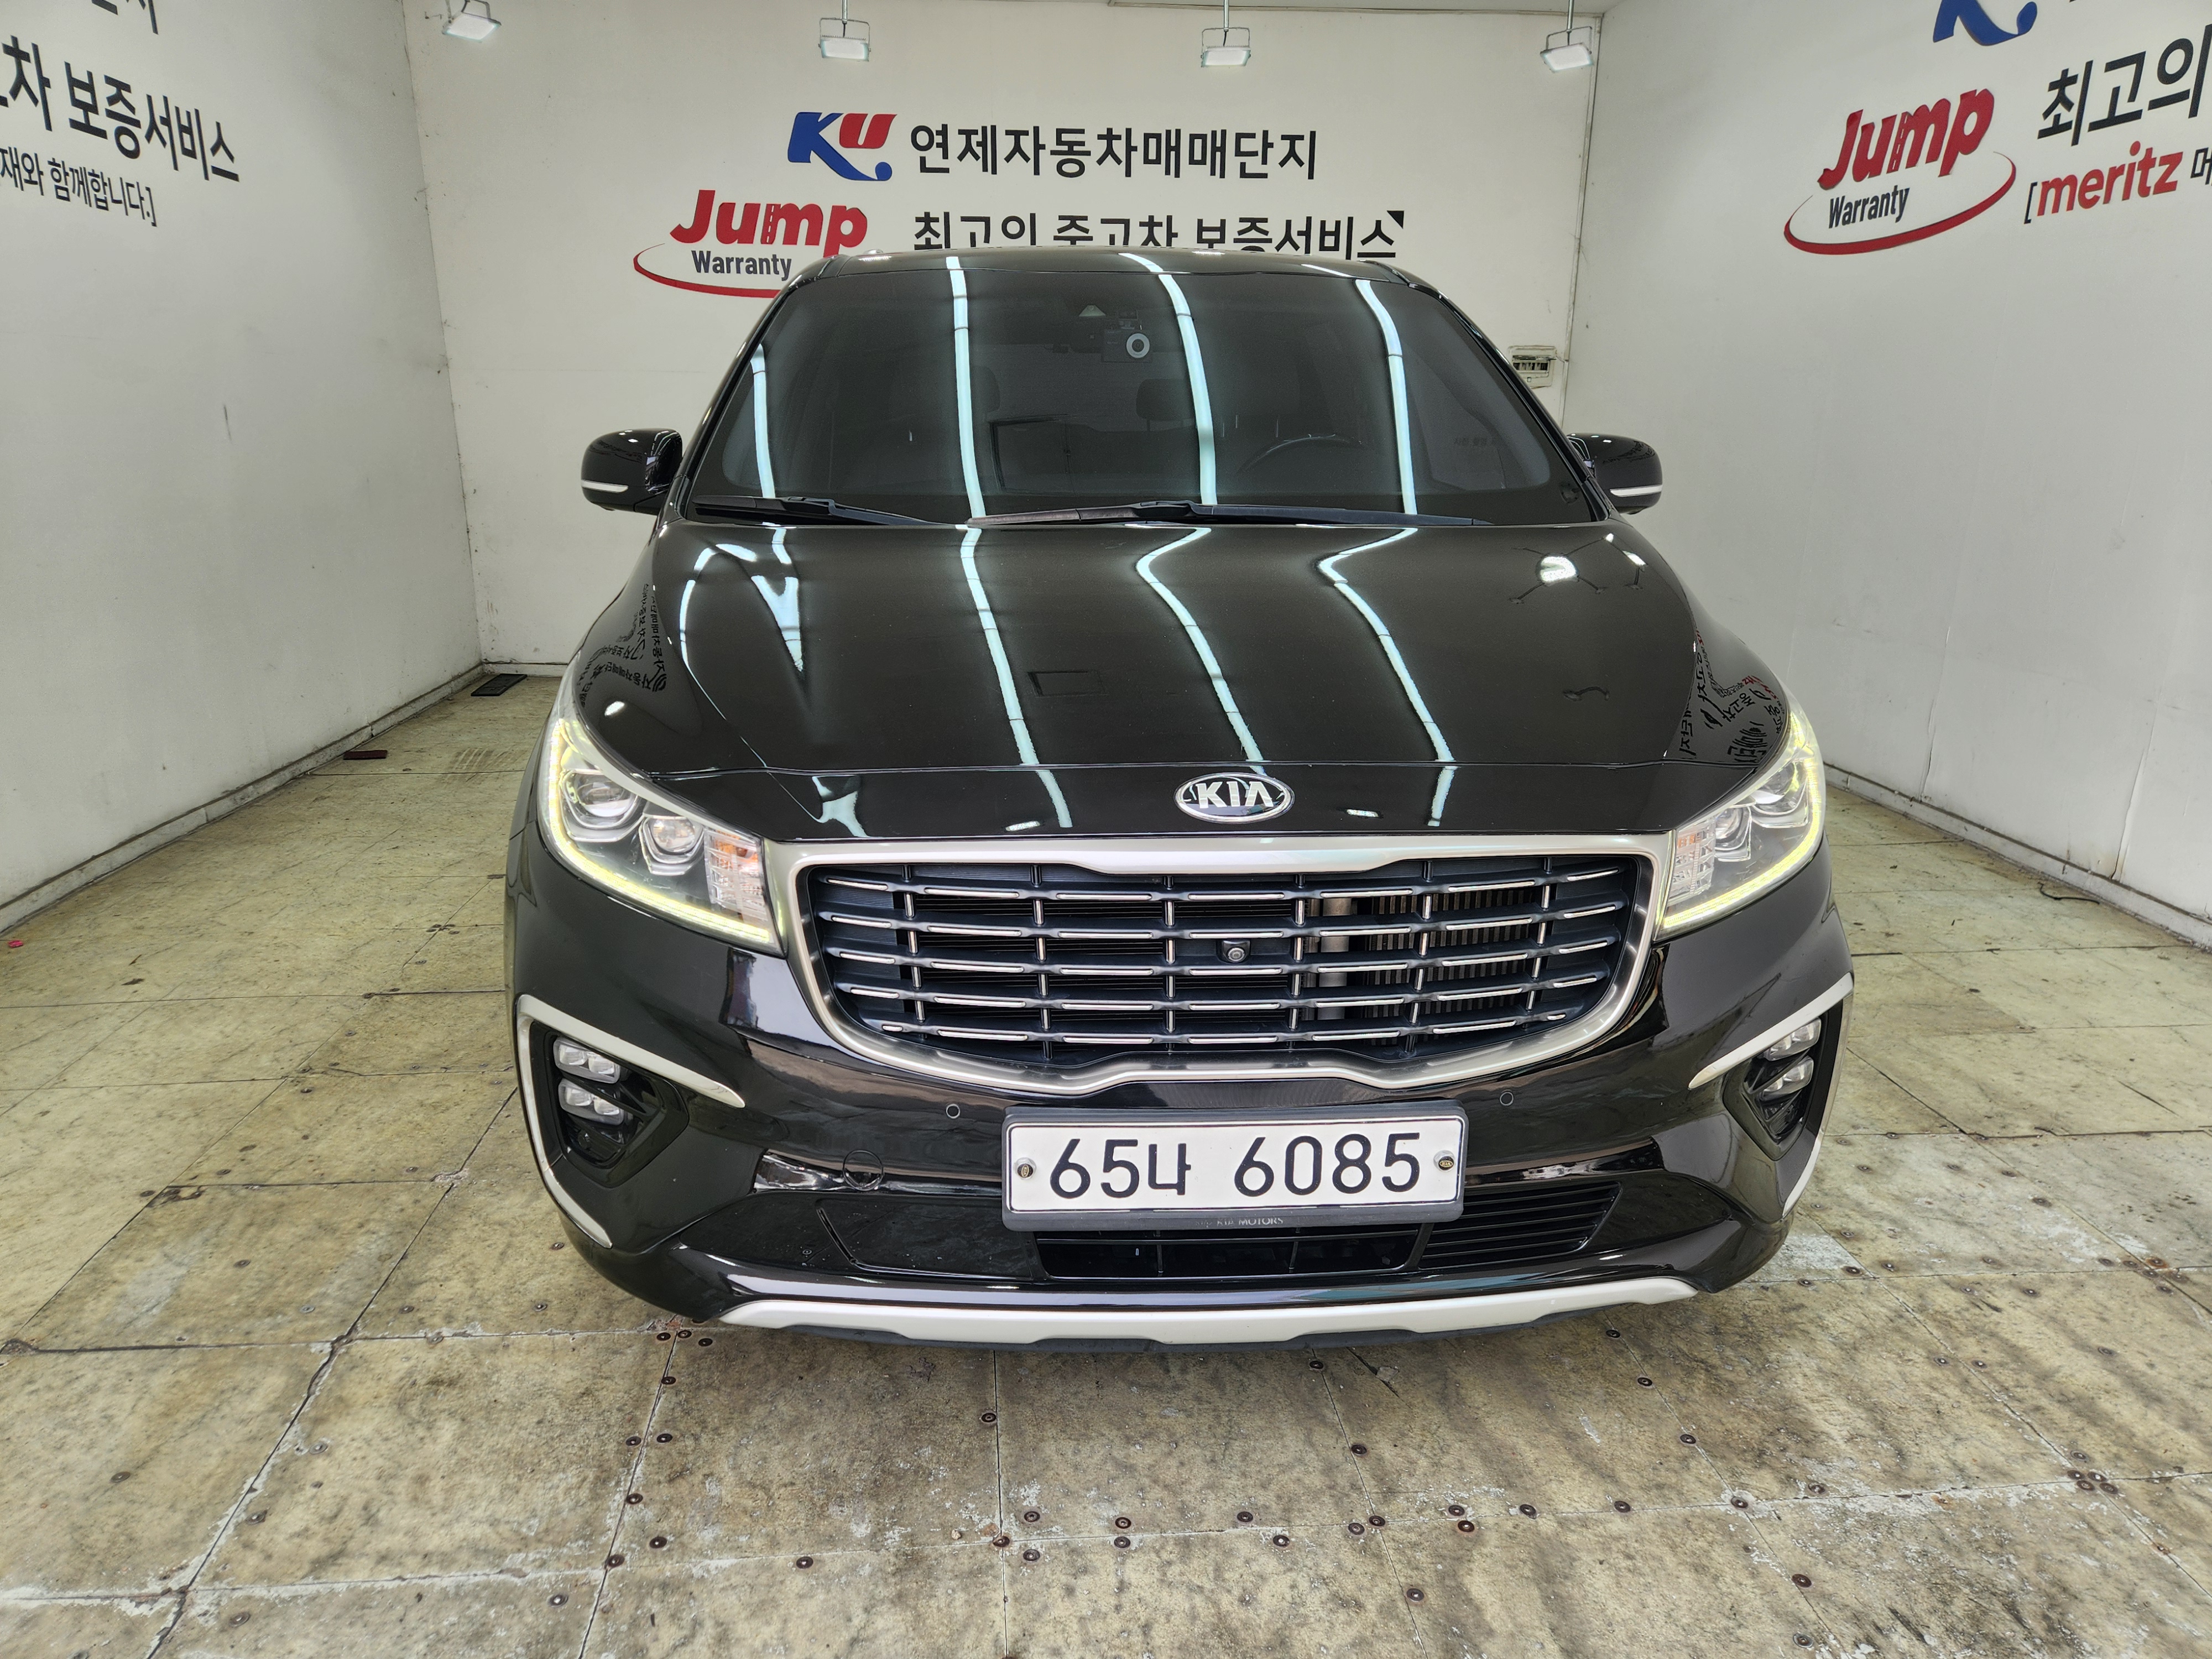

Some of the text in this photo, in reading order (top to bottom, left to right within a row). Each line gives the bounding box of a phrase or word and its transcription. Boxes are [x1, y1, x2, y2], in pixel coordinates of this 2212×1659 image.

[0, 35, 239, 182] 차 보증서비스
[2037, 23, 2212, 146] 최고의
[911, 123, 1317, 180] 연제자동차매매단지
[1817, 88, 1995, 190] Jump
[47, 157, 157, 227] 함께합니다.]
[670, 190, 867, 258] Jump
[1828, 185, 1910, 228] Warranty
[691, 250, 792, 281] Warranty
[1196, 781, 1274, 808] KIA
[1049, 1133, 1421, 1199] 65나 6085
[1238, 1217, 1284, 1226] MOTORS
